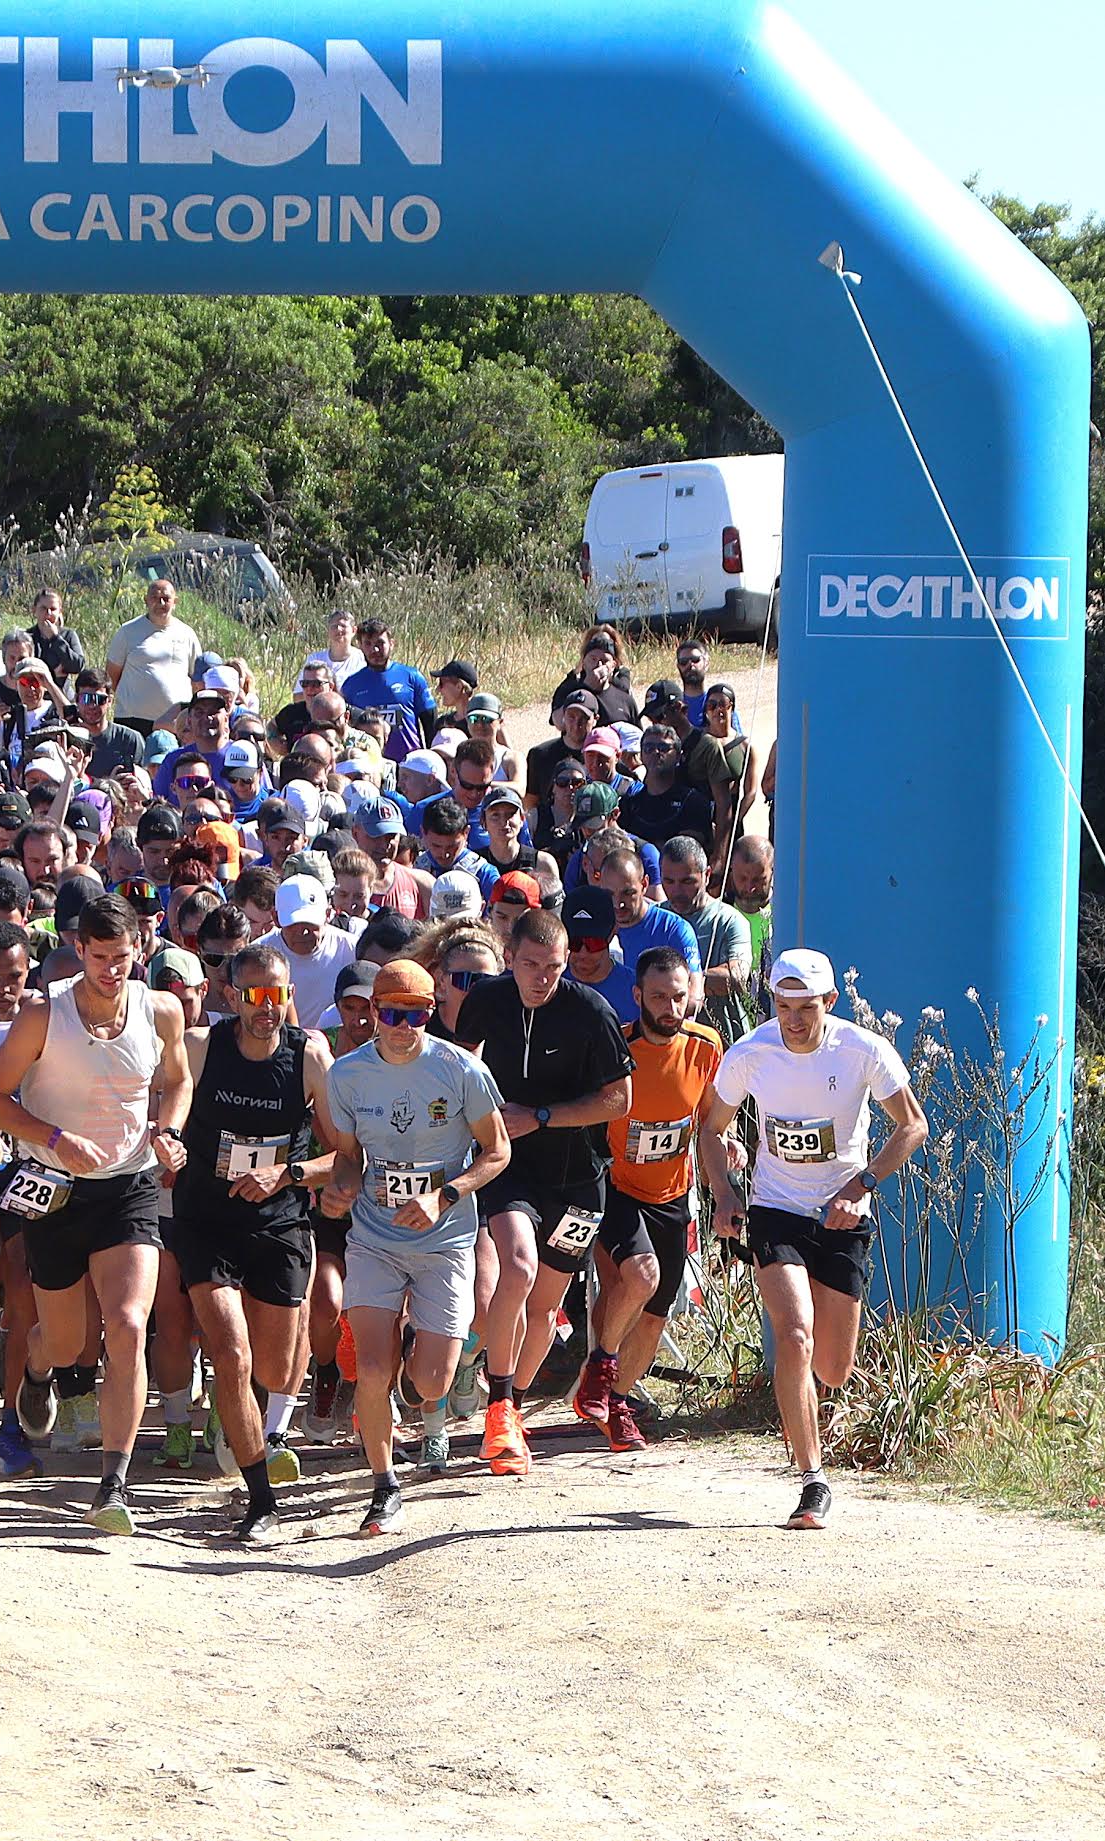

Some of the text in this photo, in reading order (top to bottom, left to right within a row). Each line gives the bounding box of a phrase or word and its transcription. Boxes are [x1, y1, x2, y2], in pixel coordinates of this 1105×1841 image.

[30, 193, 442, 243] CARCOPINO
[818, 574, 1059, 620] DECATHLON
[648, 1133, 673, 1151] 14
[777, 1132, 819, 1151] 239
[248, 1151, 259, 1169] 1
[9, 1175, 52, 1206] 228
[388, 1175, 429, 1195] 217
[563, 1222, 591, 1243] 23
